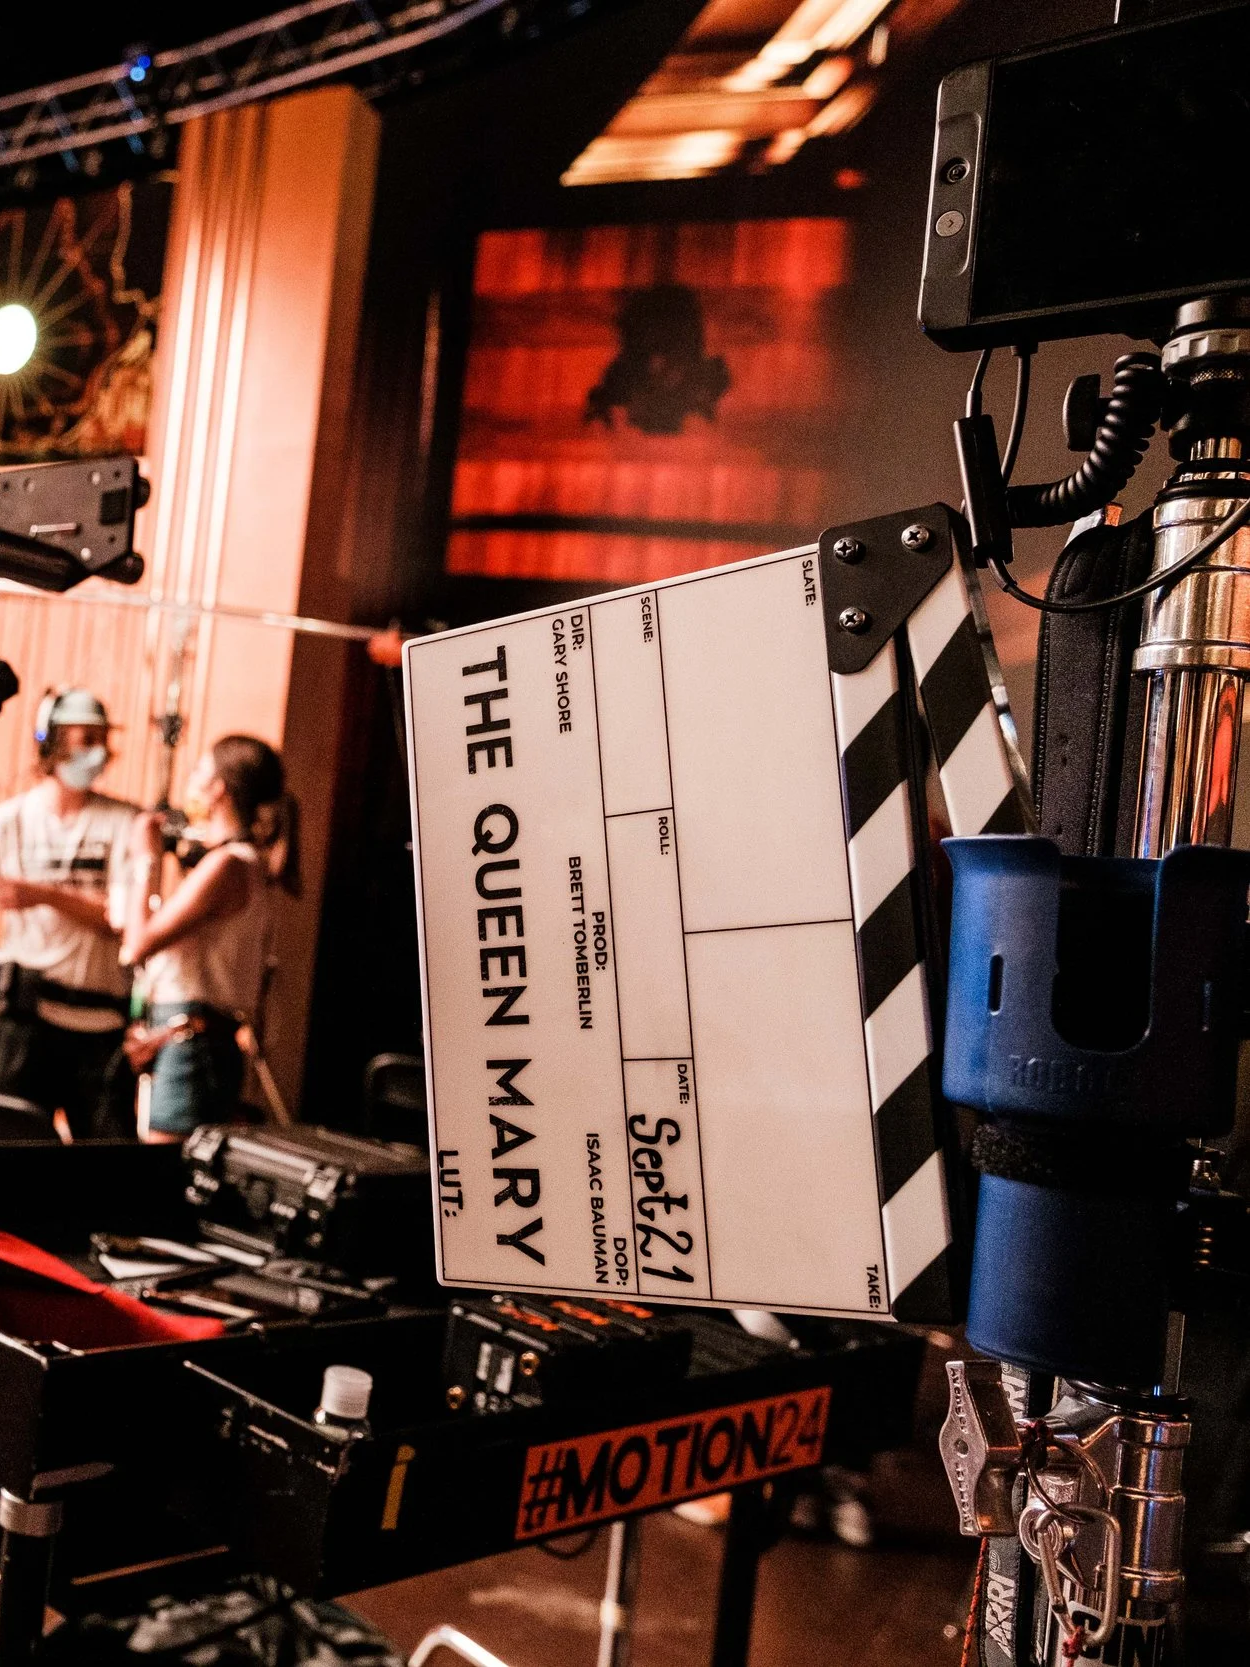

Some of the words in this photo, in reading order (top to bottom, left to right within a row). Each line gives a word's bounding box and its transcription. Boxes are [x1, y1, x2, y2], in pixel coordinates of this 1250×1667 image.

[802, 560, 816, 606] SLATE:
[552, 619, 567, 667] GARY
[571, 614, 584, 650] DIR:
[640, 596, 653, 643] SCENE:
[461, 645, 514, 774] THE
[556, 672, 571, 734] SHORE
[658, 816, 670, 855] ROLL:
[569, 856, 586, 914] BRETT
[472, 804, 530, 1026] QUEEN
[592, 912, 608, 970] PROD:
[573, 919, 593, 1030] TOMBERLIN
[678, 1064, 690, 1104] DATE:
[437, 1149, 463, 1218] LUT:
[486, 1059, 546, 1267] MARY
[586, 1133, 603, 1192] ISAAC
[591, 1197, 610, 1285] BAUMAN
[614, 1238, 629, 1286] DOP:
[866, 1264, 881, 1309] TAKE:
[949, 1367, 968, 1435] Avenger
[522, 1394, 824, 1533] #MOTION24
[985, 1573, 1017, 1660] ARRI
